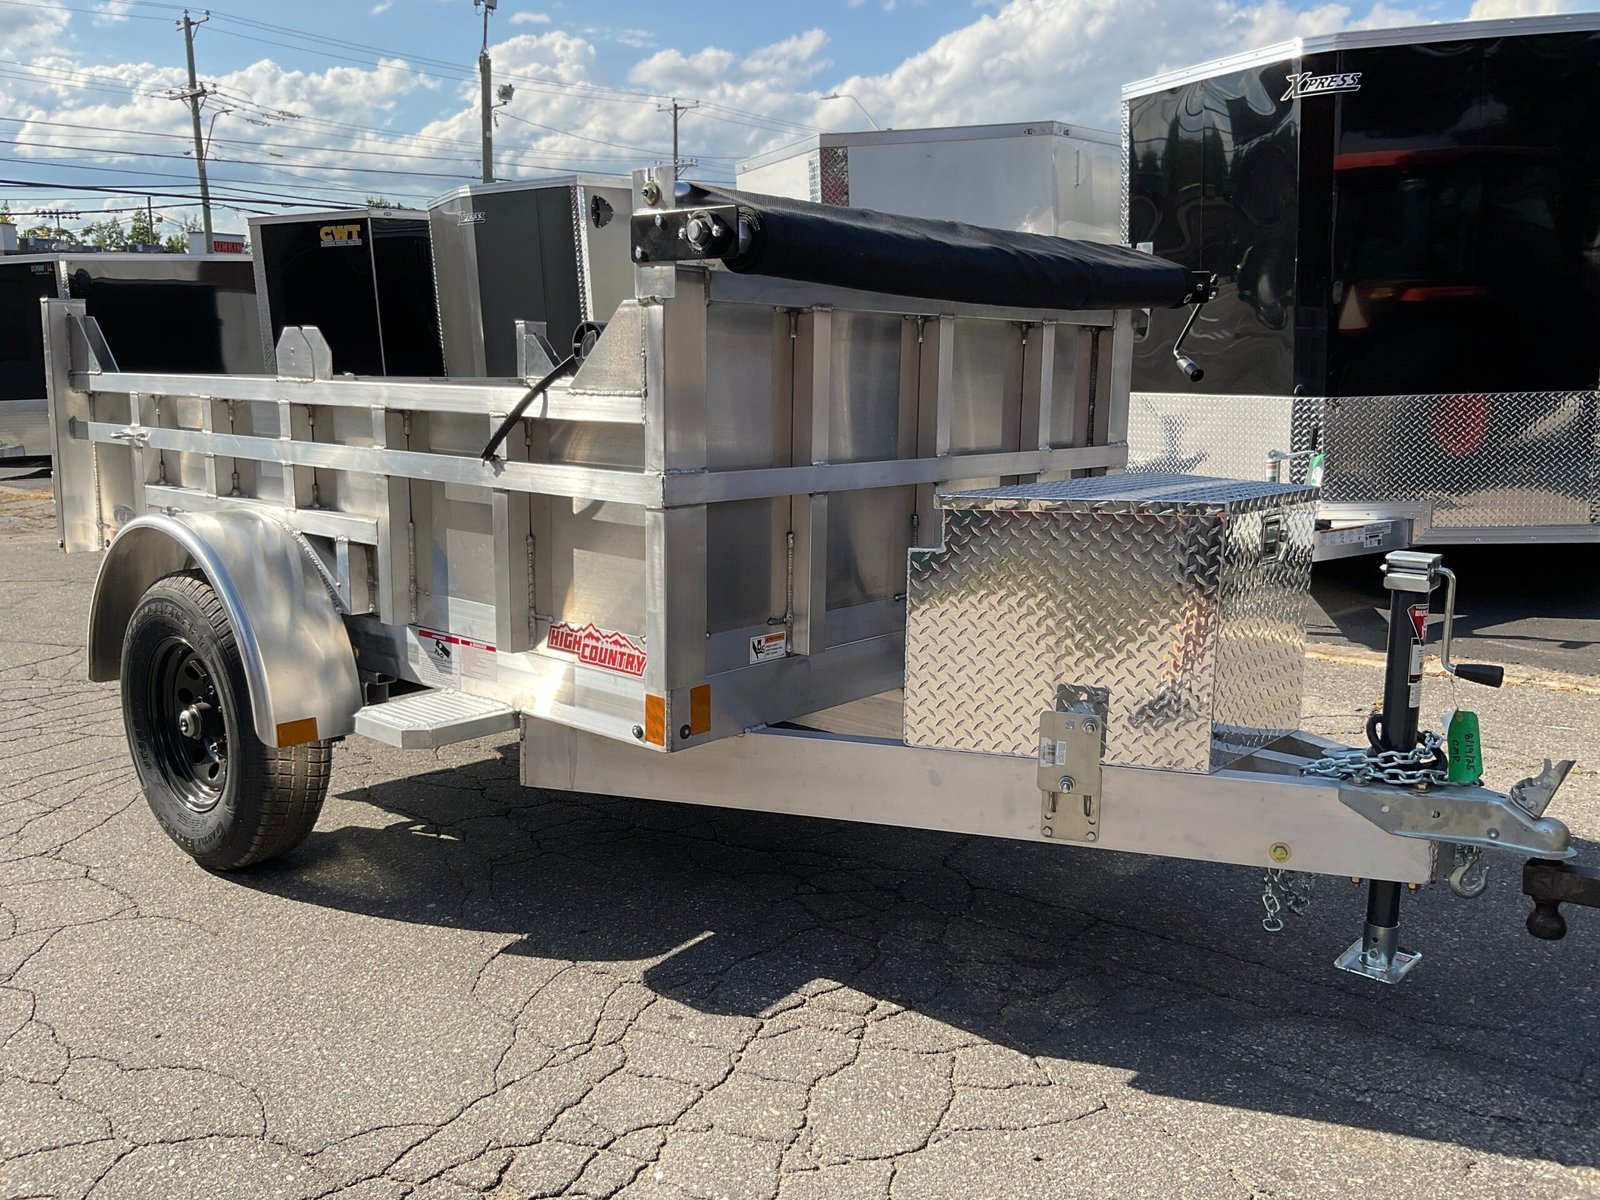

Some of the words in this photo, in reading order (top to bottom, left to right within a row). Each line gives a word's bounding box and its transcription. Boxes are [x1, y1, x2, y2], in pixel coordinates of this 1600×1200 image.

[1280, 72, 1363, 101] XPRESS
[320, 225, 361, 241] CWT
[550, 630, 583, 652] HIGH
[581, 643, 647, 673] COUNTRY
